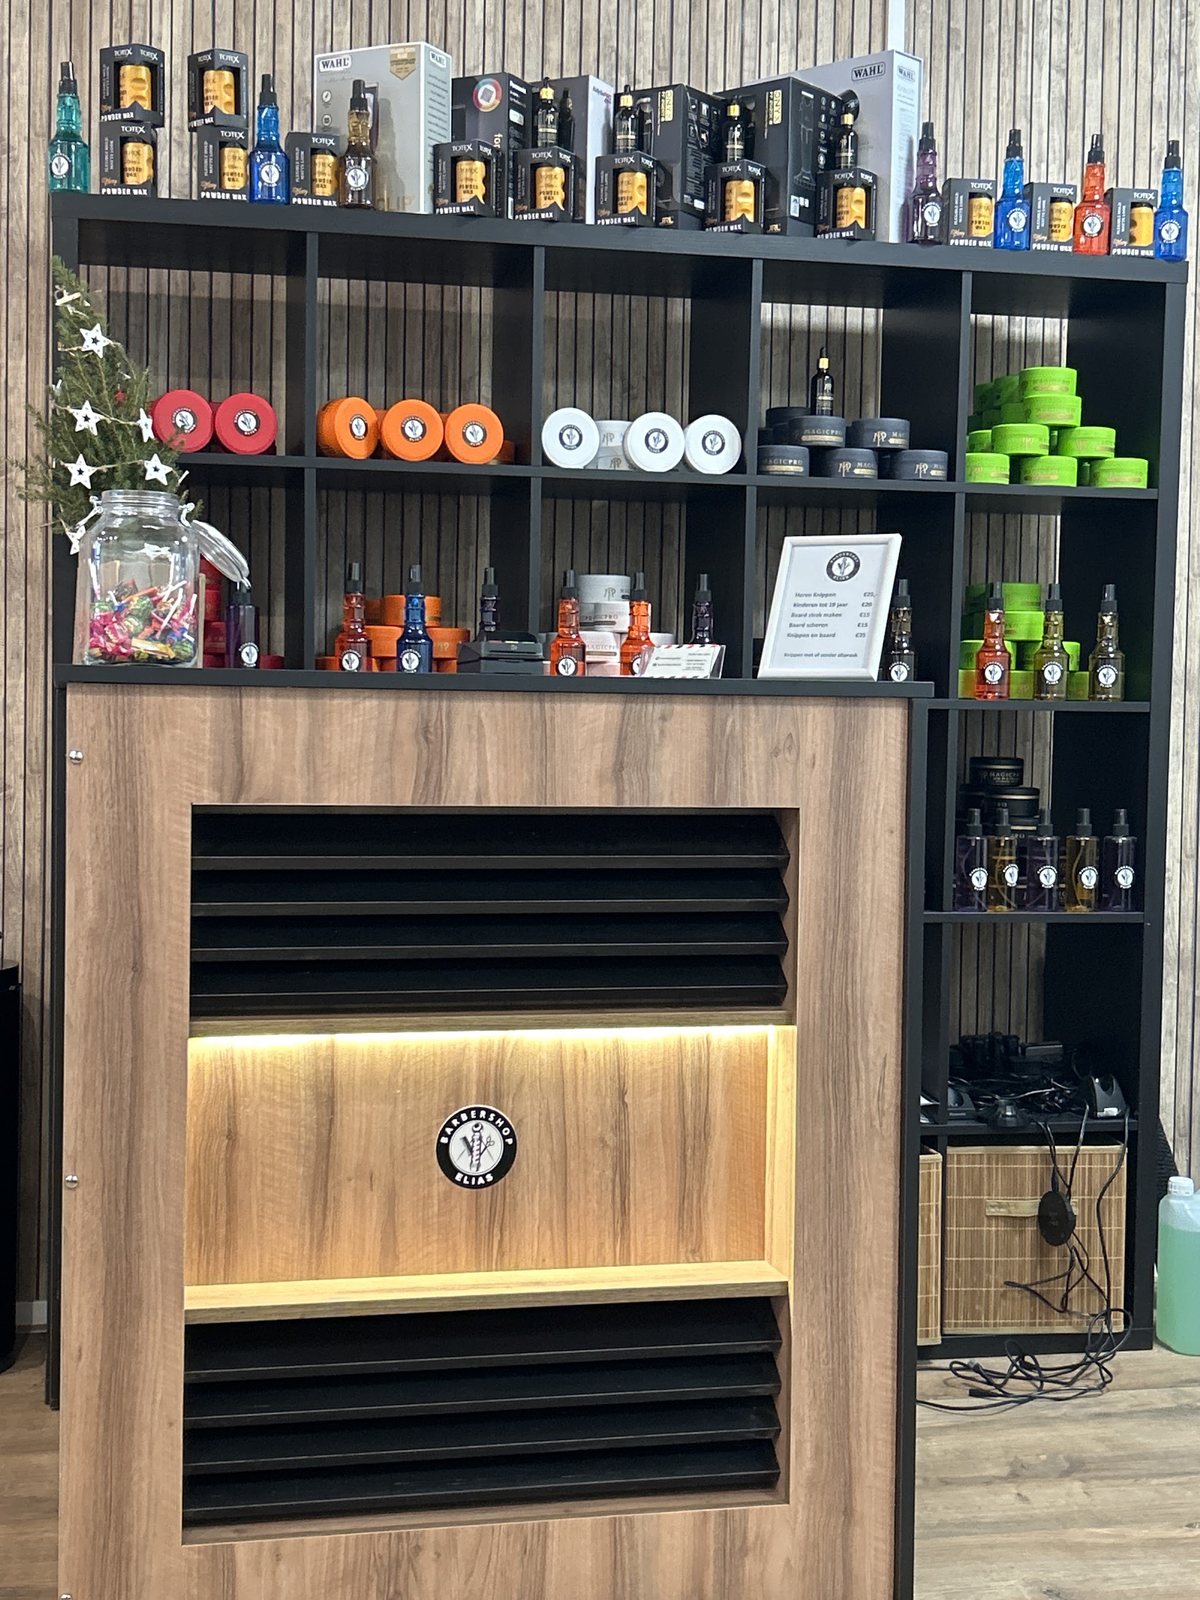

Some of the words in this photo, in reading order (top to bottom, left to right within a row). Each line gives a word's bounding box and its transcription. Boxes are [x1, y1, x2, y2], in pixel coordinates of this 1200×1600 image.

[321, 58, 348, 69] WAHL
[854, 65, 883, 78] WAHL
[121, 126, 146, 134] TOTEX
[221, 130, 245, 140] TOTEX
[312, 137, 335, 146] TOTEX
[201, 192, 231, 200] POWDER
[292, 198, 321, 206] POWDER
[436, 206, 460, 215] POWDER
[597, 217, 621, 225] POWDER
[1032, 243, 1059, 251] POWDER
[1112, 248, 1139, 256] POWDER
[440, 1110, 514, 1145] BARBERSHOP
[455, 1172, 493, 1185] ELIAS
